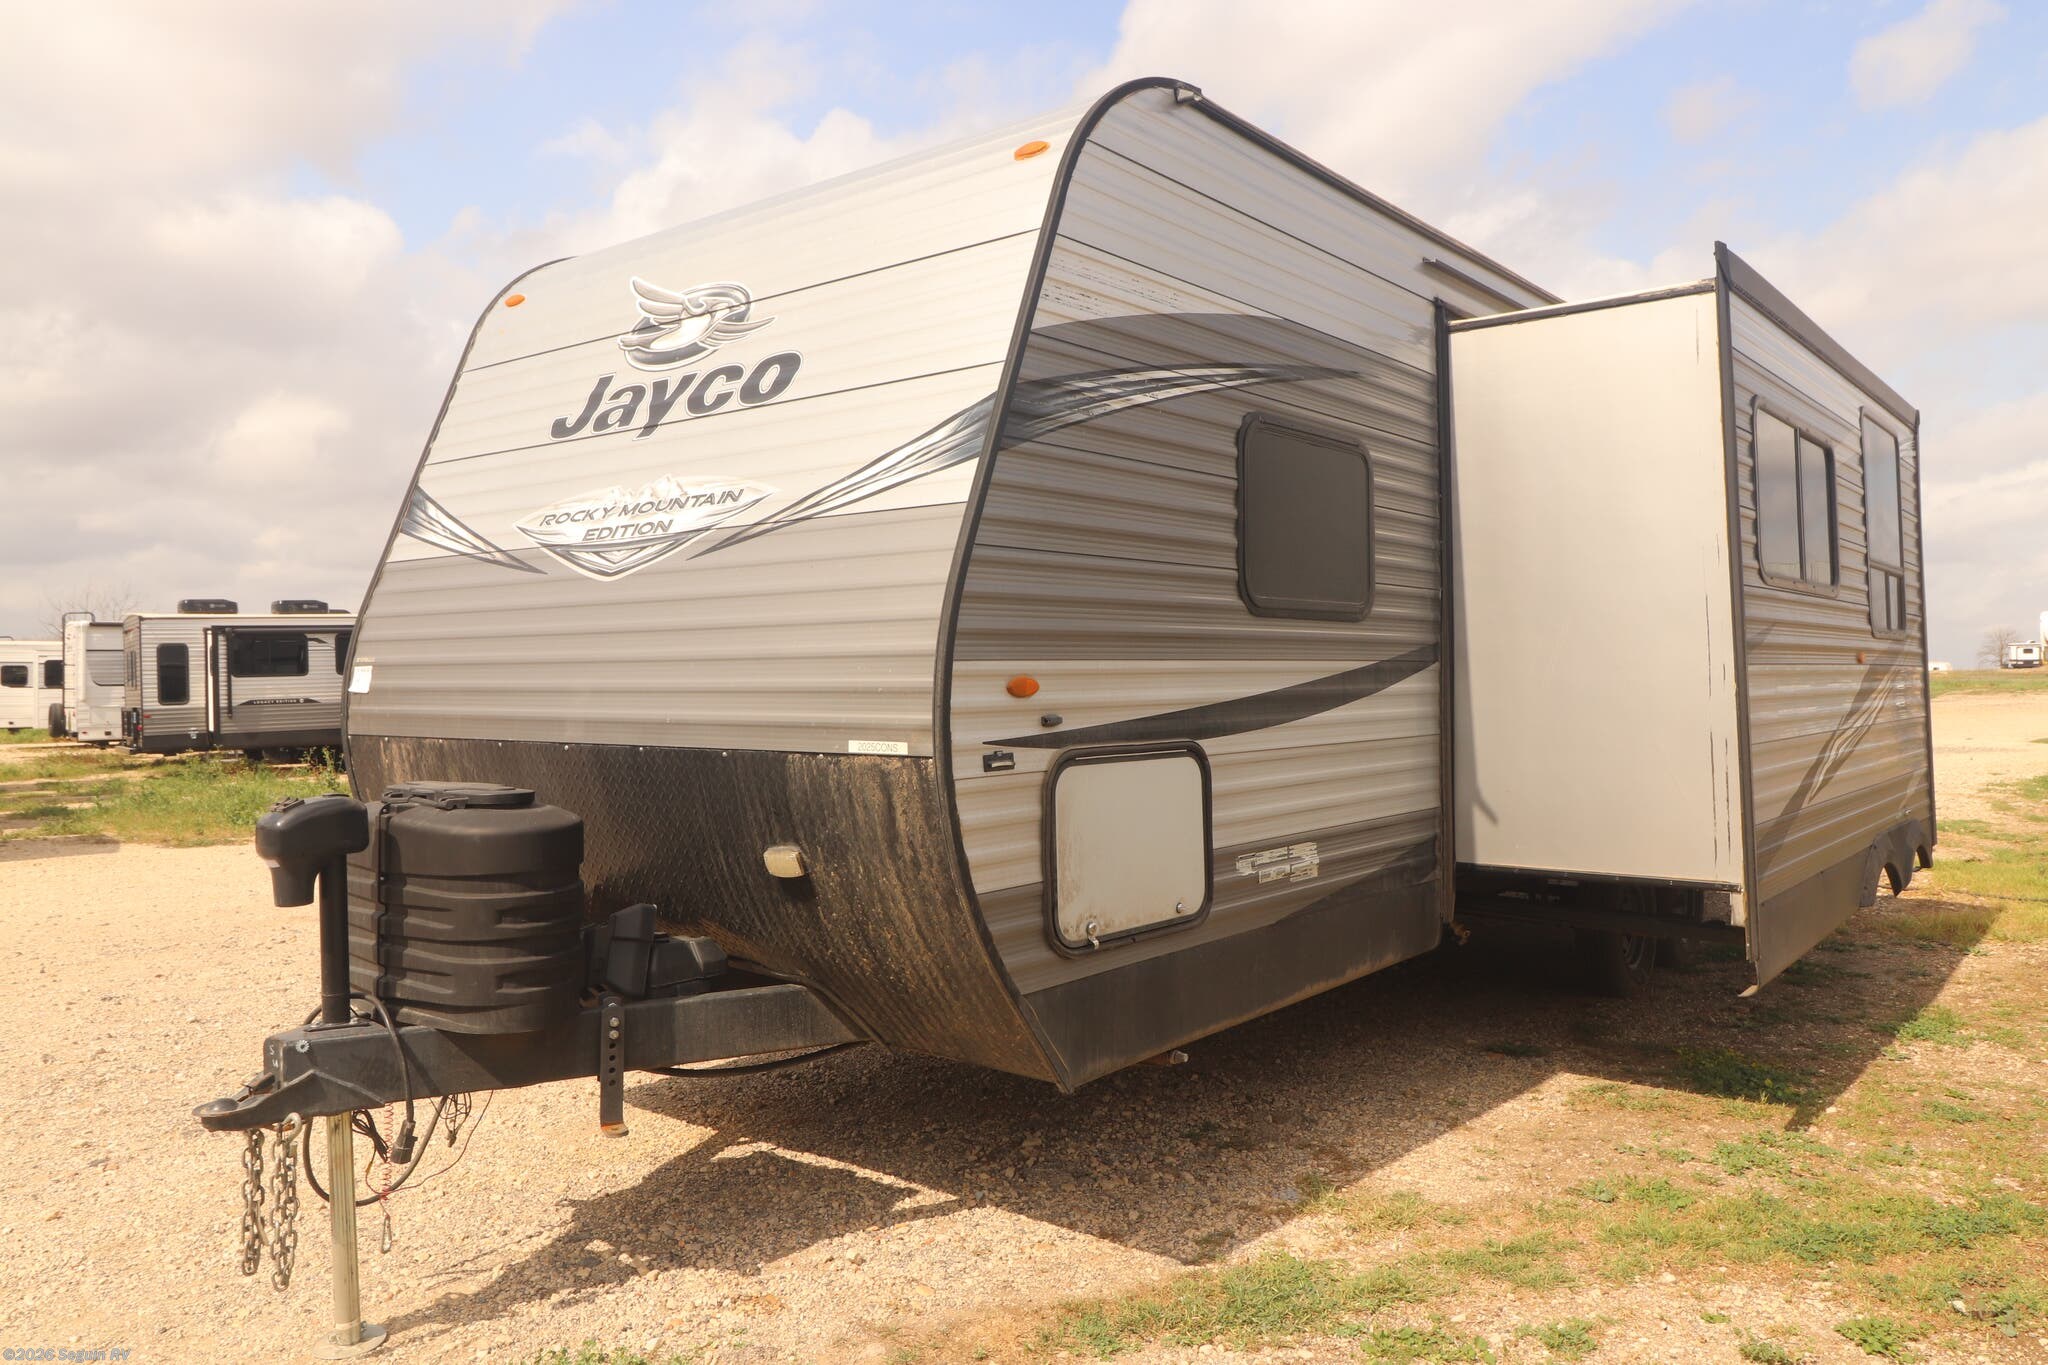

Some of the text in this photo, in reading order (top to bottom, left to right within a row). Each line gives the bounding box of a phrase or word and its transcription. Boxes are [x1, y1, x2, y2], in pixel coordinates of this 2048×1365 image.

[550, 350, 802, 439] Jayco
[539, 488, 745, 527] ROCKY MOUNTAIN
[582, 519, 674, 542] EDITION
